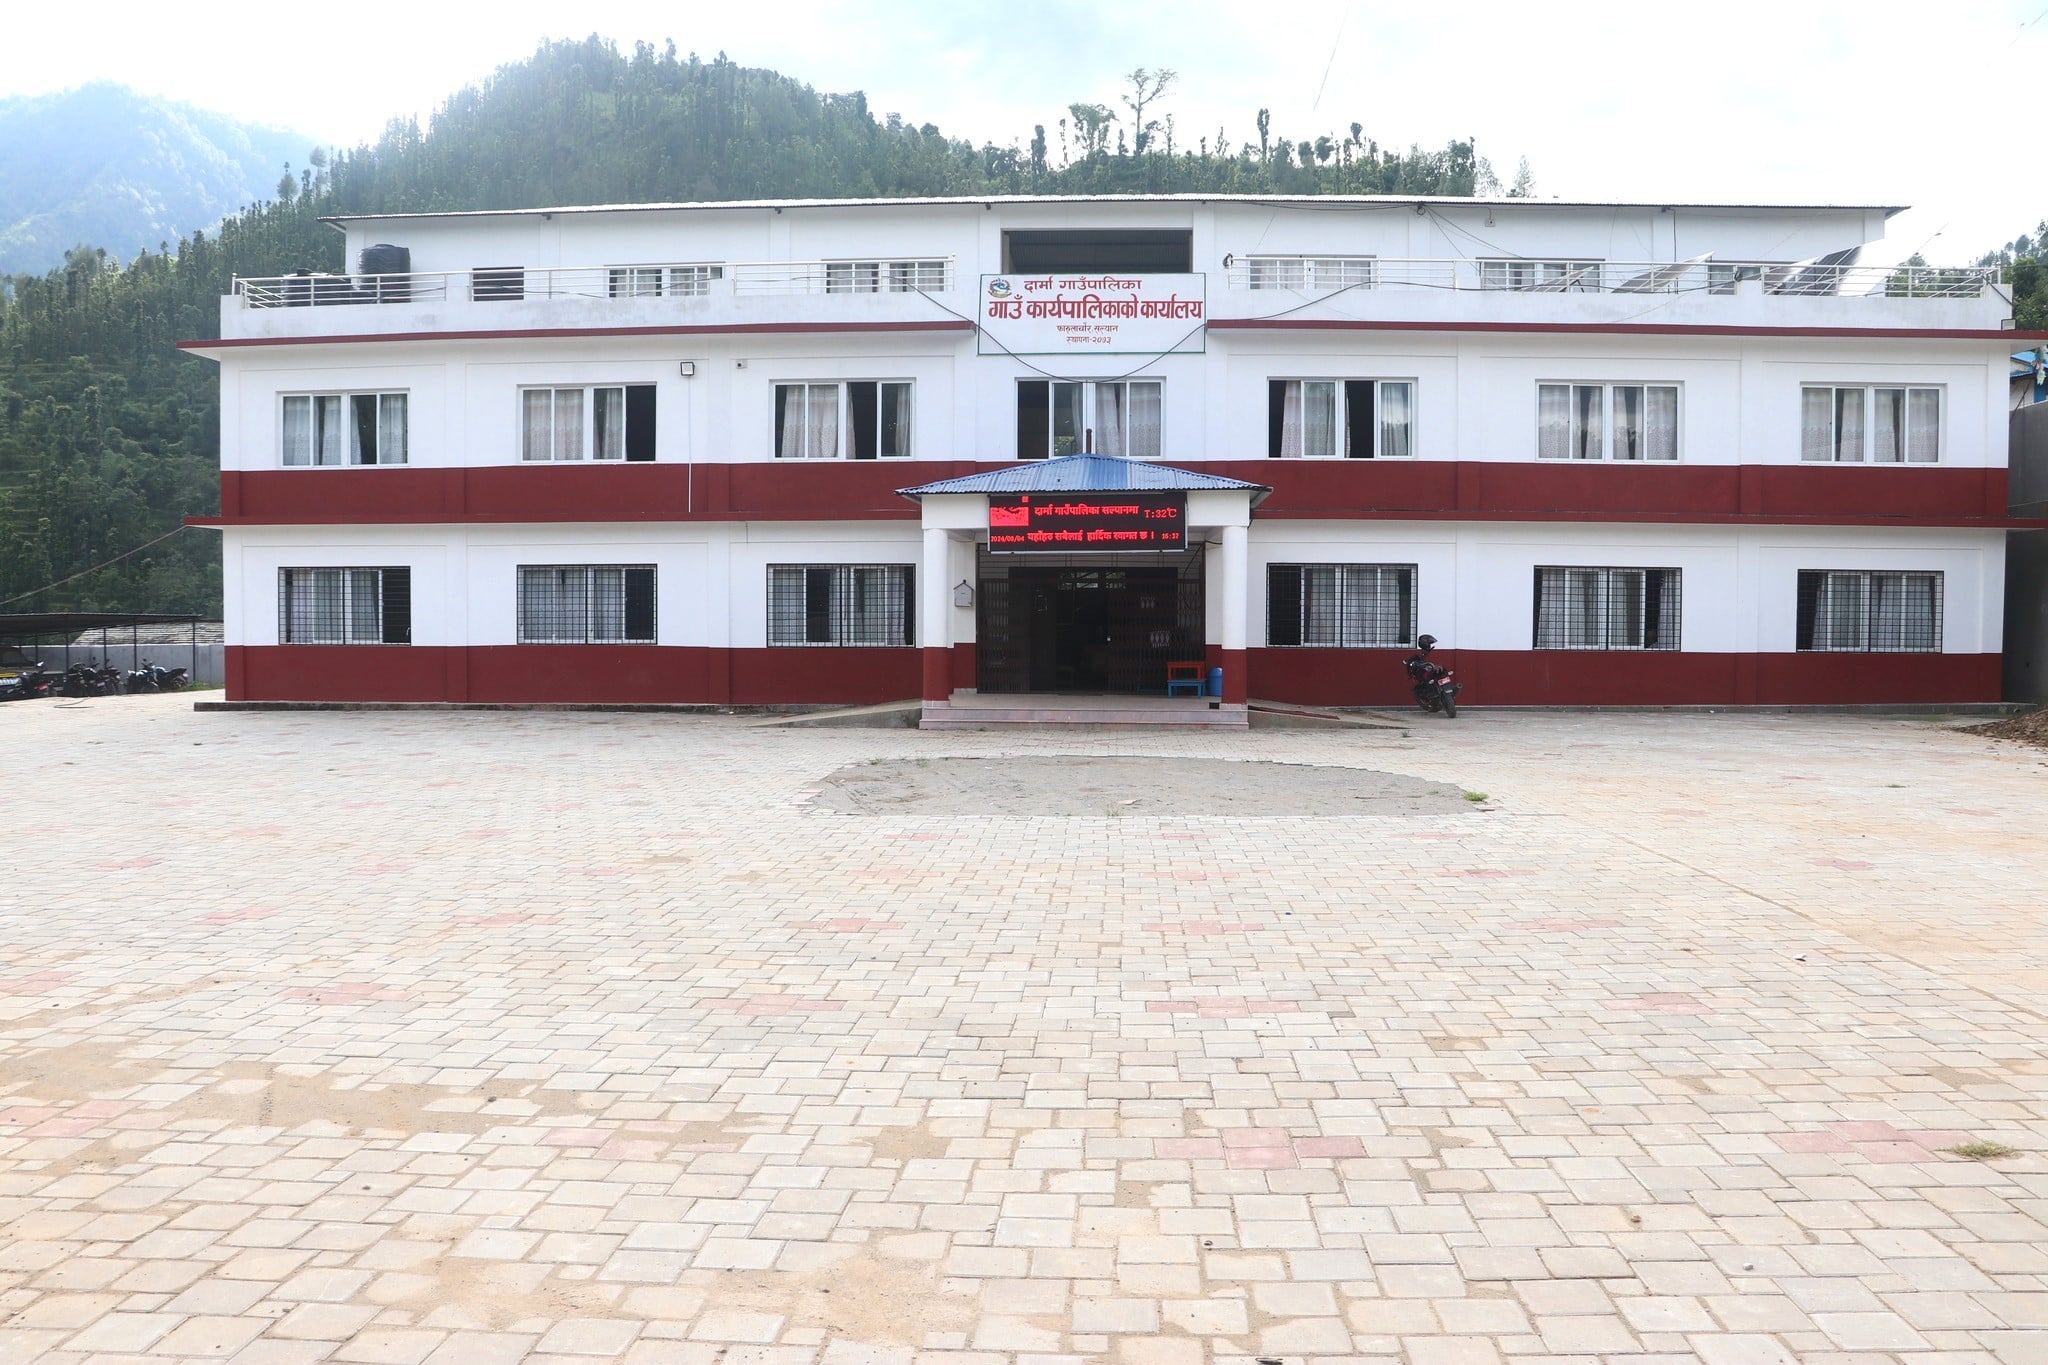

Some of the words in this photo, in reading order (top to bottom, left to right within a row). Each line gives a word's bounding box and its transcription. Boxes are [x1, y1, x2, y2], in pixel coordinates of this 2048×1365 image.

[1024, 276, 1053, 293] दार्मा
[1059, 276, 1142, 291] गाउँपालिका
[988, 294, 1023, 319] गाउँ
[1026, 293, 1139, 319] कार्यपालिकाको
[1141, 294, 1203, 320] कार्यालय
[1034, 503, 1053, 516] दार्मा
[1054, 503, 1100, 516] गाउँपालिका
[1054, 529, 1084, 541] सबैलाई
[1087, 529, 1112, 542] हार्दिक
[1113, 531, 1138, 541] स्वागत
